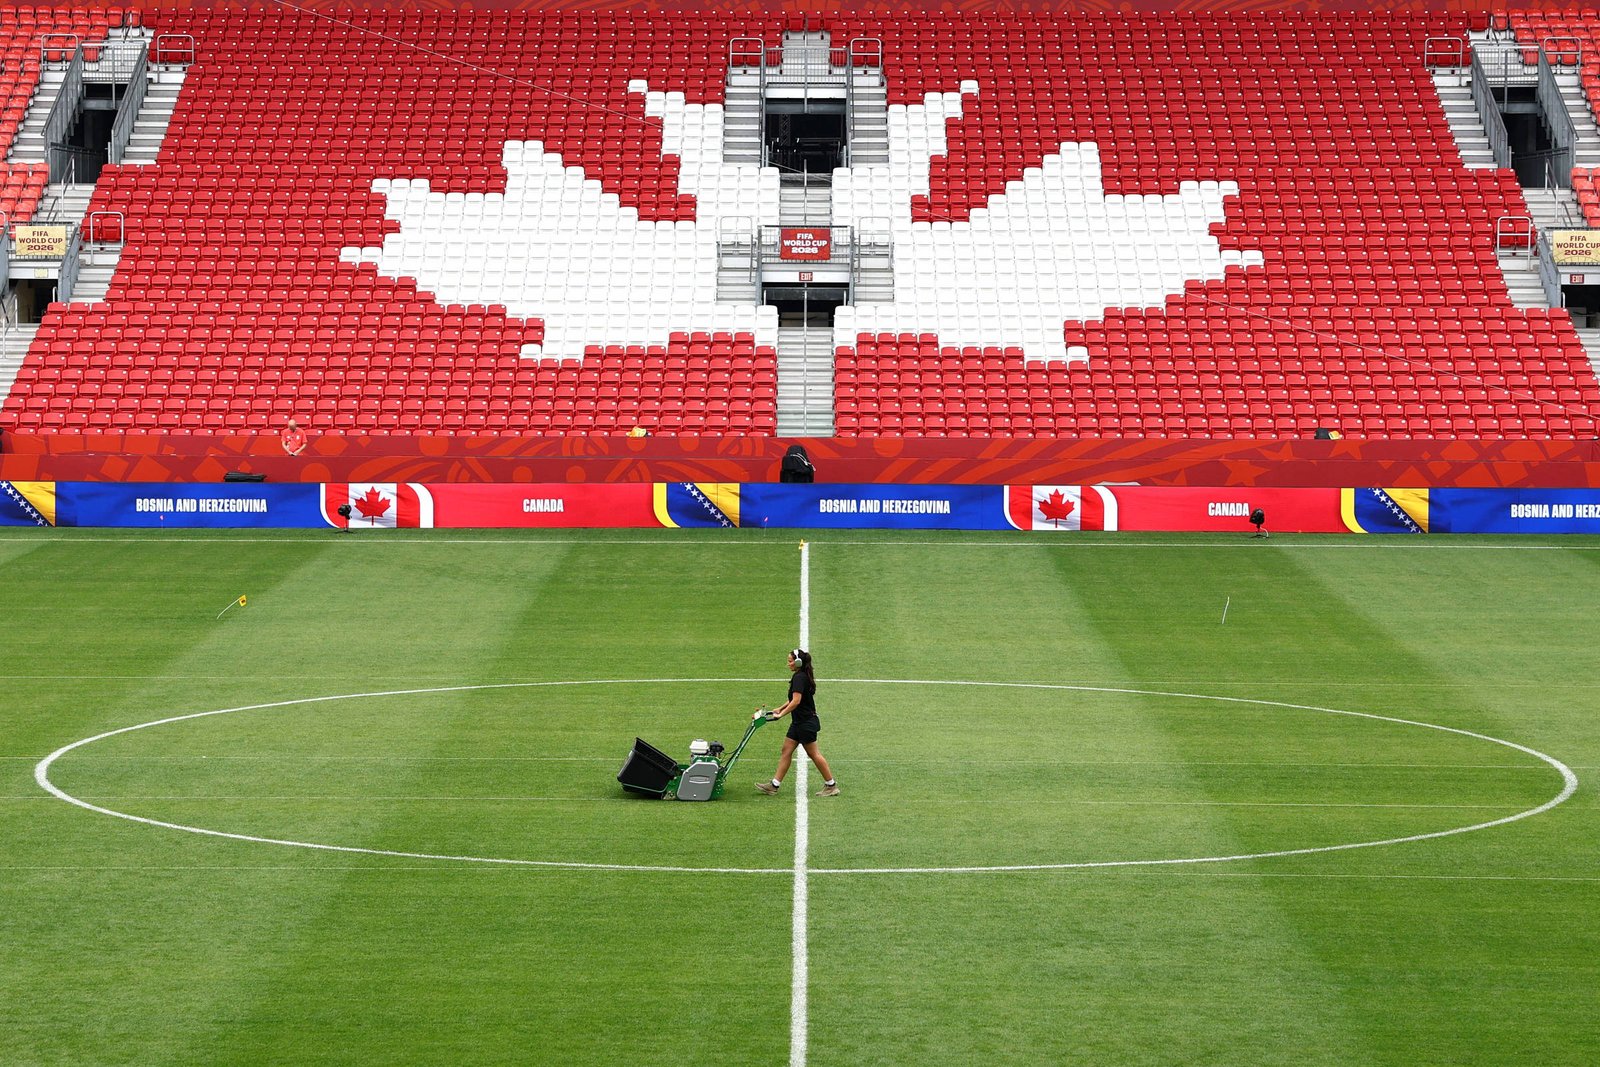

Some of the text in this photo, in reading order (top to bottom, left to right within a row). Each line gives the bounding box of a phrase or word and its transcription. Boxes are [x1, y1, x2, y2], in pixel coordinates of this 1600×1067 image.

[136, 498, 267, 512] BOSNIA AND HERZEGOVINA
[523, 499, 564, 512] CANADA
[820, 499, 950, 514] BOSNIA AND HERZEGOVINA
[1208, 502, 1250, 516] CANADA
[1511, 504, 1550, 518] BOSNIA
[1551, 504, 1573, 518] AND
